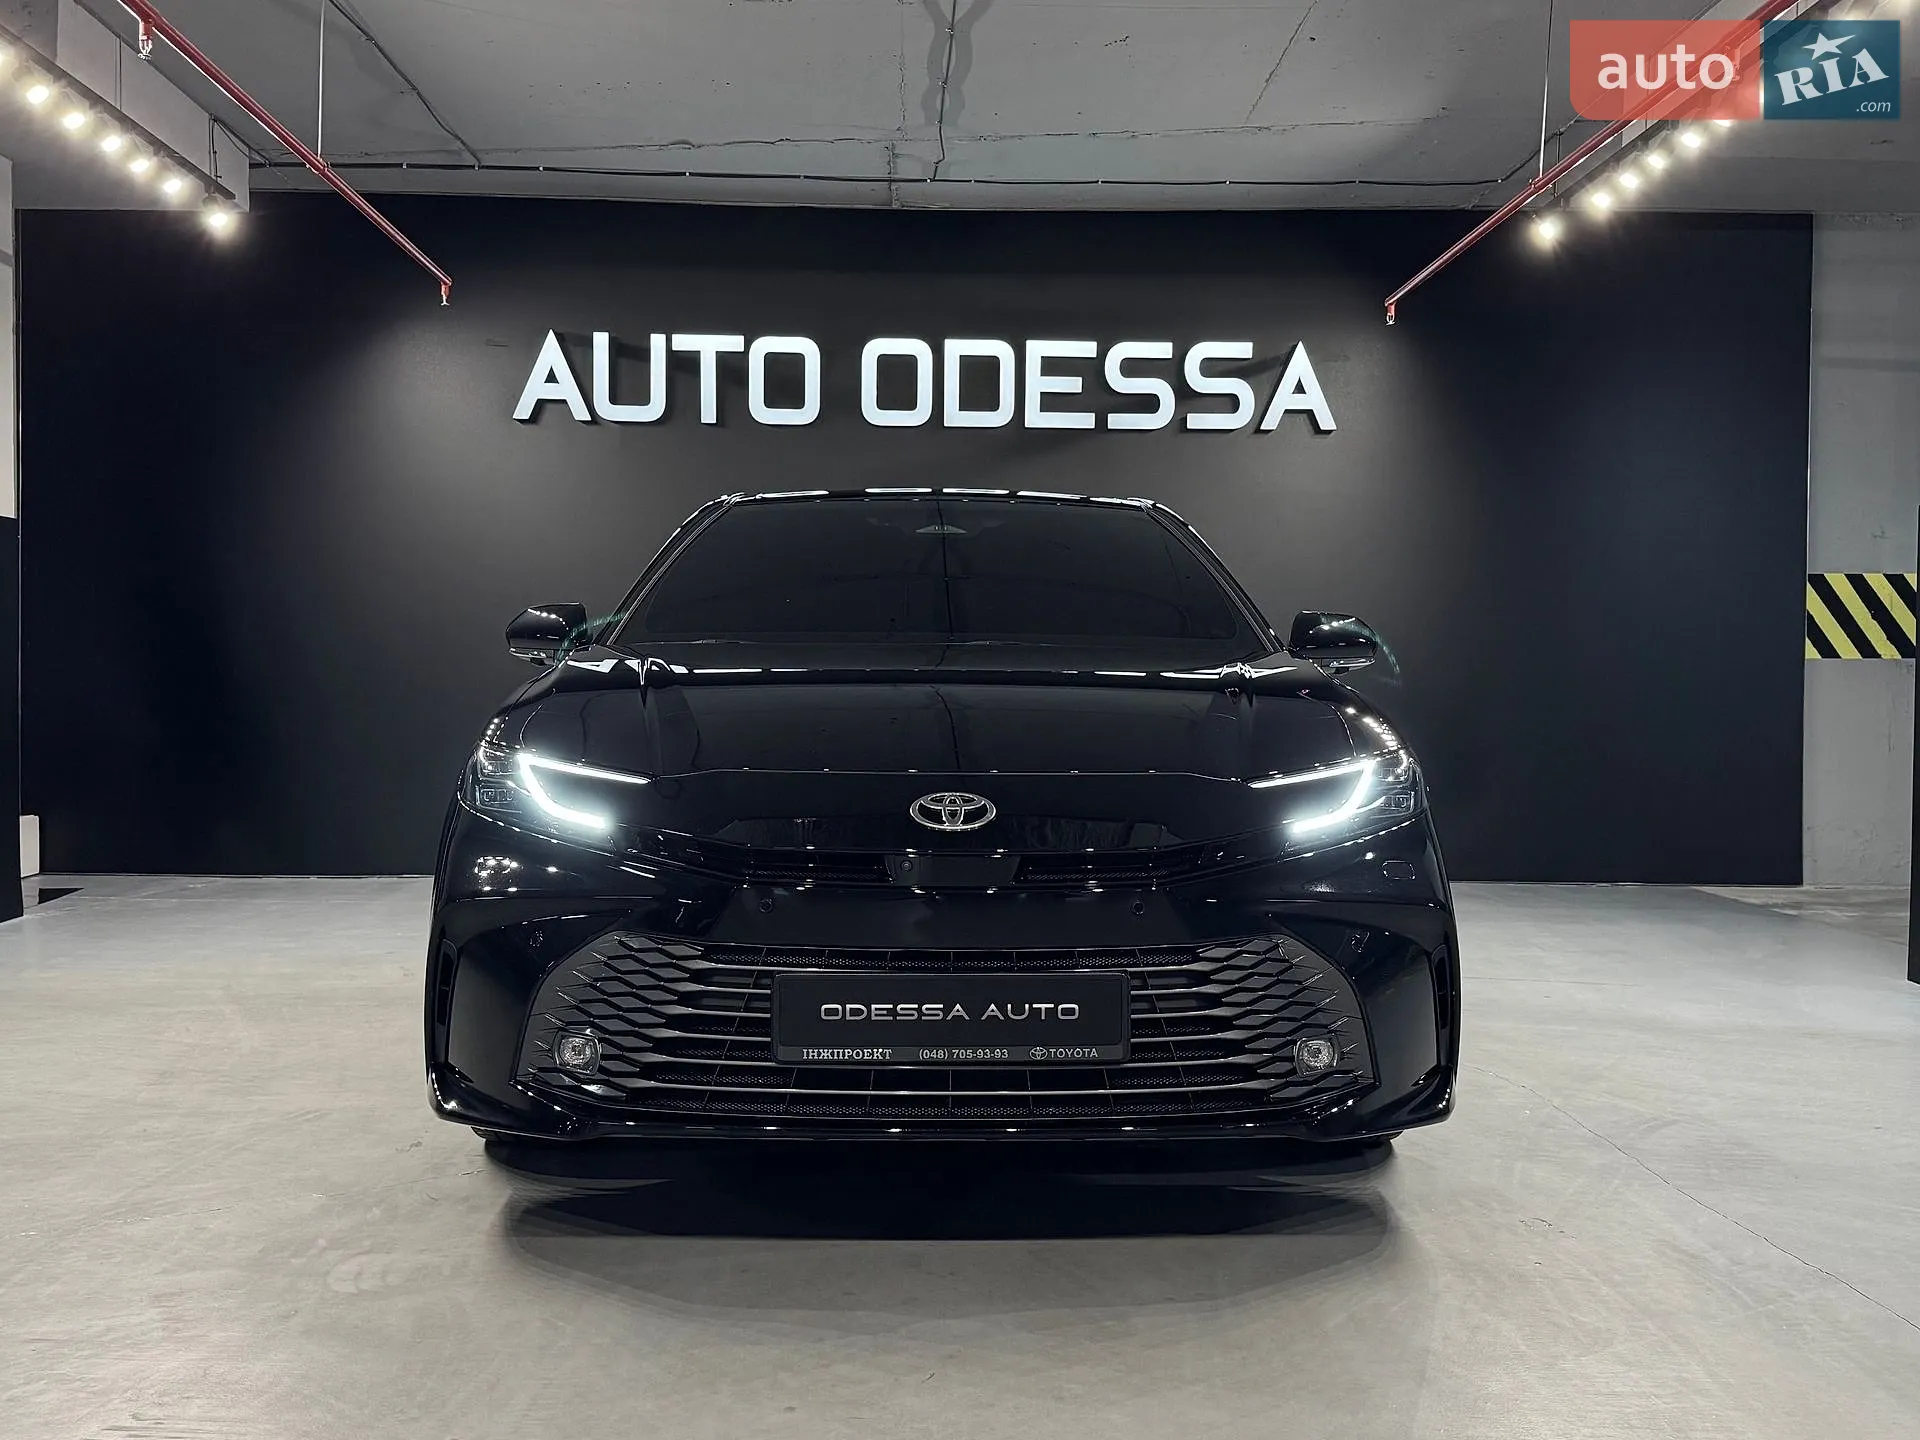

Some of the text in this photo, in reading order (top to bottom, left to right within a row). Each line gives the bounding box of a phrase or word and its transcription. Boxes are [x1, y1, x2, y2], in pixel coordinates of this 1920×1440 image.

[512, 328, 1338, 433] AUTO ODESSA
[819, 1003, 1080, 1021] ODESSA AUTO
[918, 1047, 1009, 1060] (048) 705-93-93
[1049, 1047, 1099, 1059] TOYOTA
